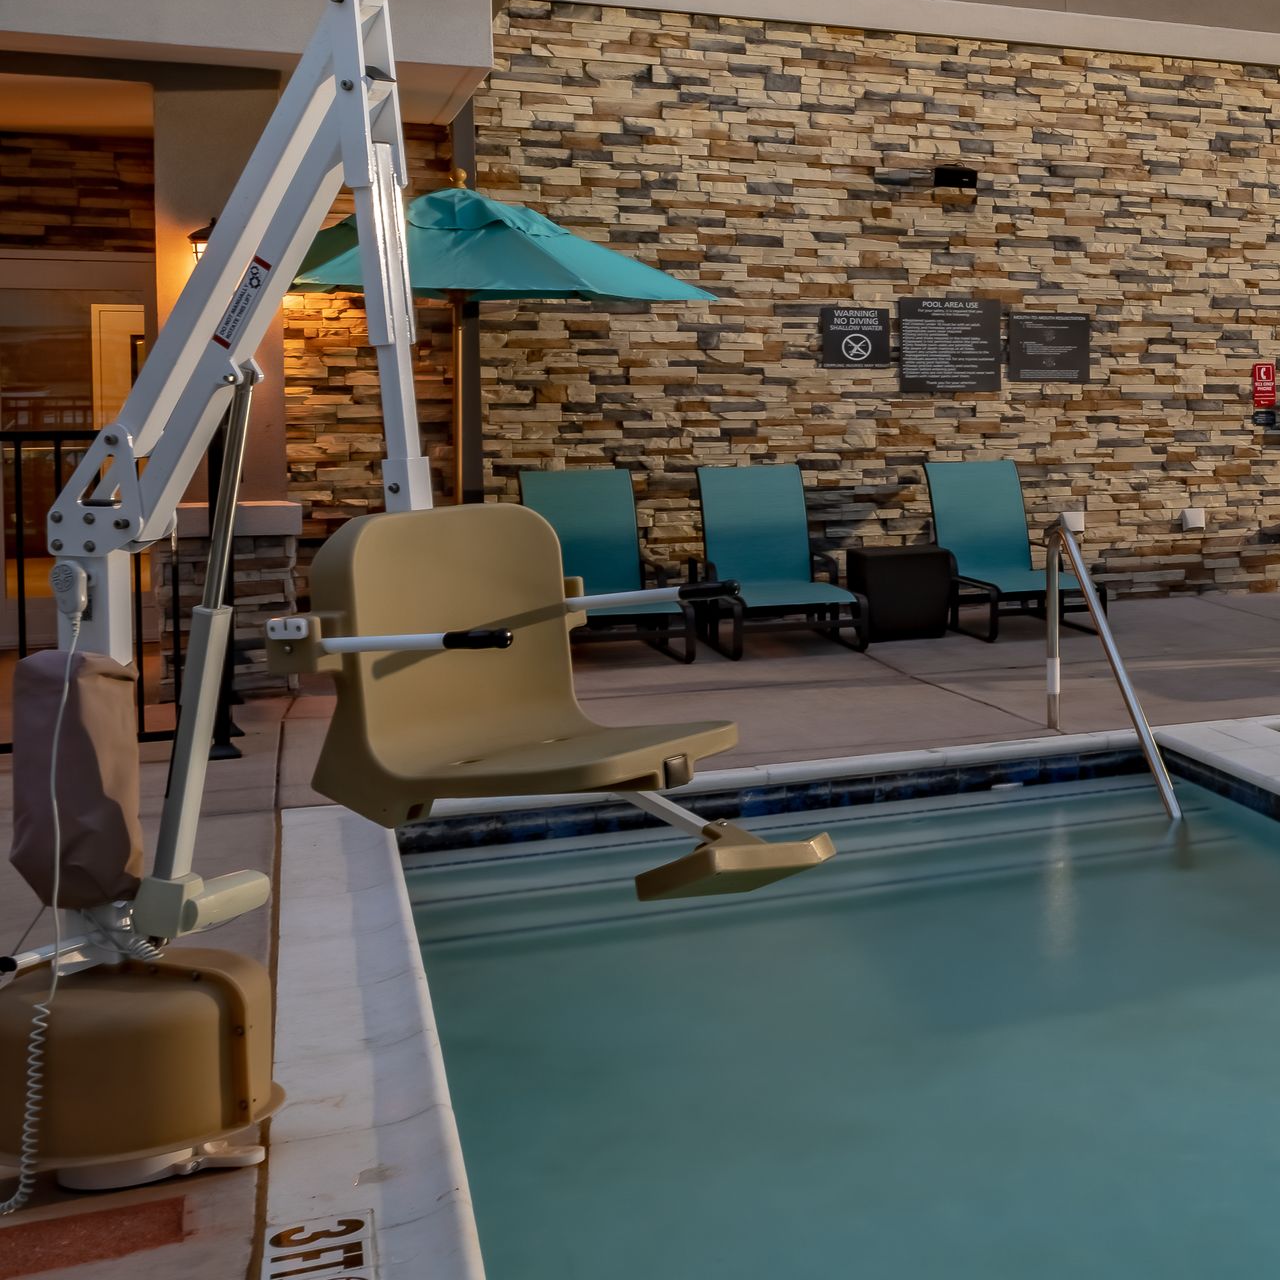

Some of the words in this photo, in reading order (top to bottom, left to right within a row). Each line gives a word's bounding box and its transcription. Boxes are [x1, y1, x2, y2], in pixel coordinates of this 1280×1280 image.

[834, 317, 847, 325] NO
[849, 317, 879, 325] DIVING
[269, 1218, 365, 1248] 3
[270, 1240, 364, 1280] FT
